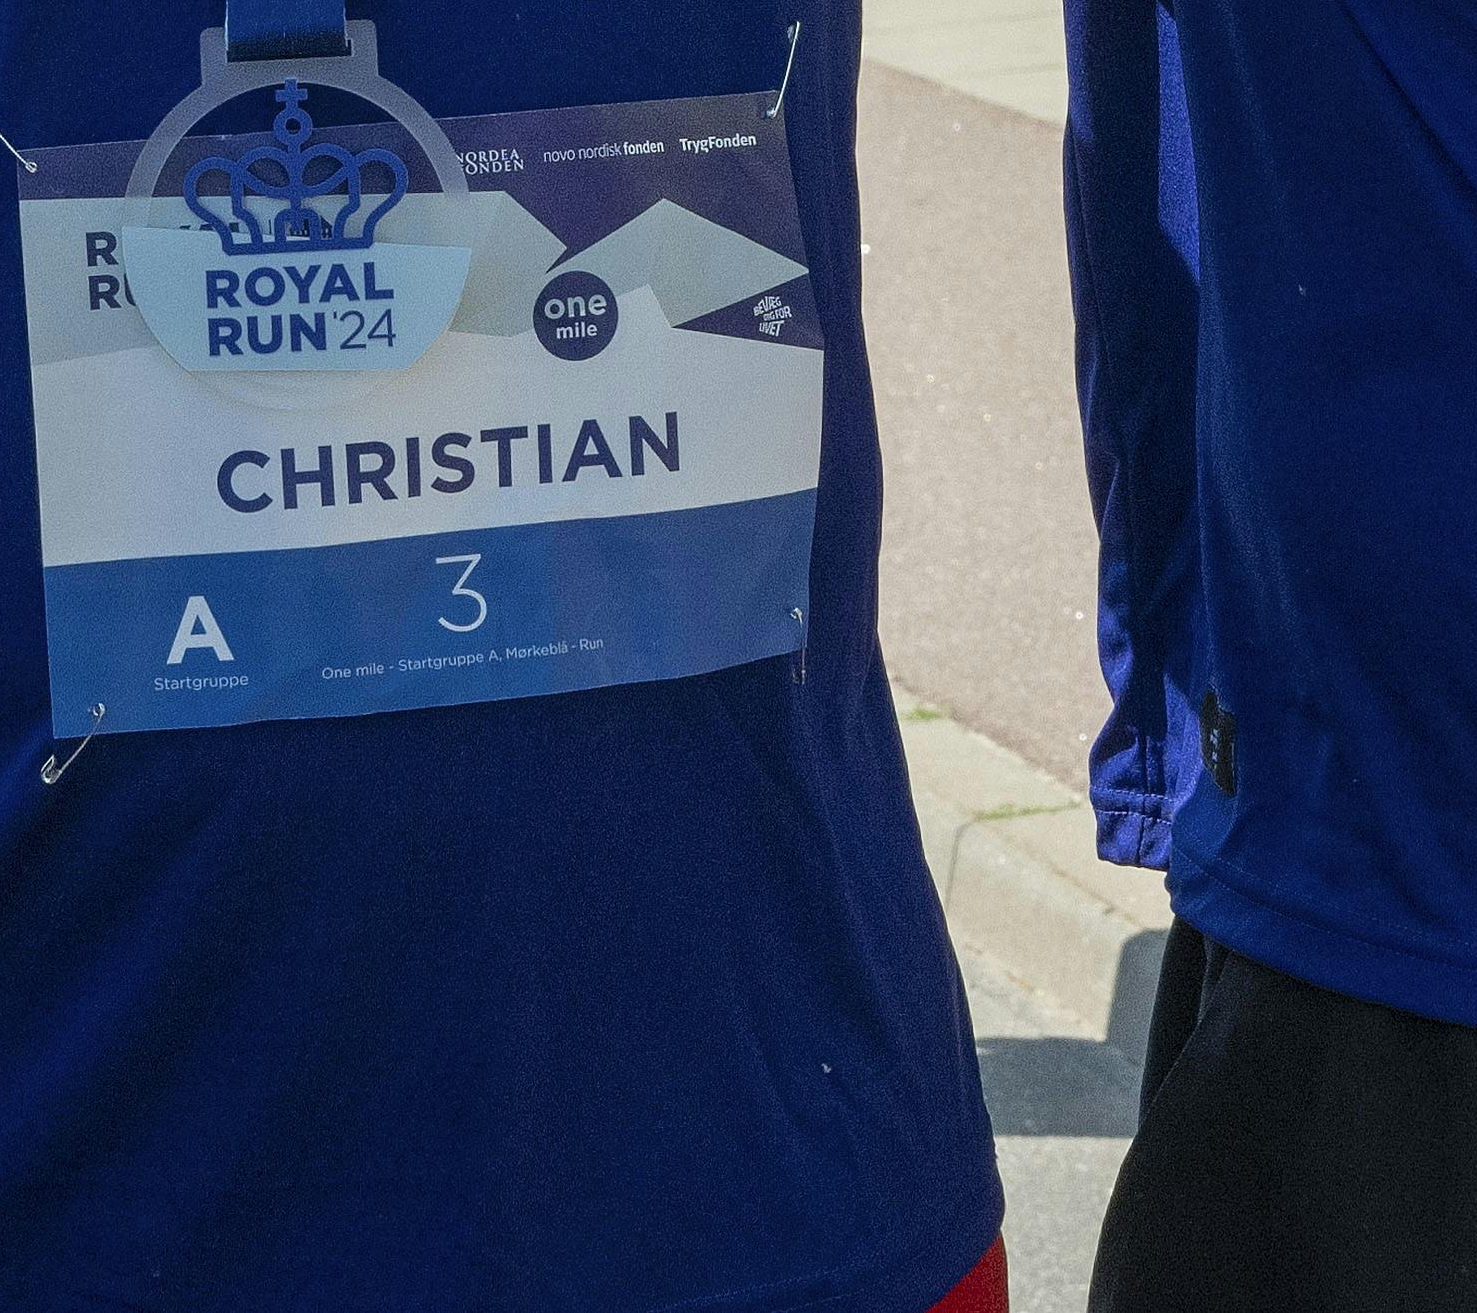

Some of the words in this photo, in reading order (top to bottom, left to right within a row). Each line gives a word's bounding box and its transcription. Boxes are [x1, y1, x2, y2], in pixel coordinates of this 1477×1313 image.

[543, 149, 576, 163] novo
[578, 143, 622, 159] nordisk
[623, 140, 665, 156] fonden
[679, 133, 757, 153] TrygFonden
[205, 262, 394, 309] ROYAL
[544, 294, 607, 320] one
[556, 321, 598, 339] mile
[217, 412, 680, 513] CHRISTIAN
[435, 554, 487, 632] 3
[166, 596, 234, 665] A
[322, 667, 352, 680] One
[356, 663, 384, 677] mile
[398, 652, 484, 672] Startgruppe
[506, 641, 568, 659] Mørkeblå
[579, 637, 604, 651] Run
[154, 673, 249, 691] Startgruppe
